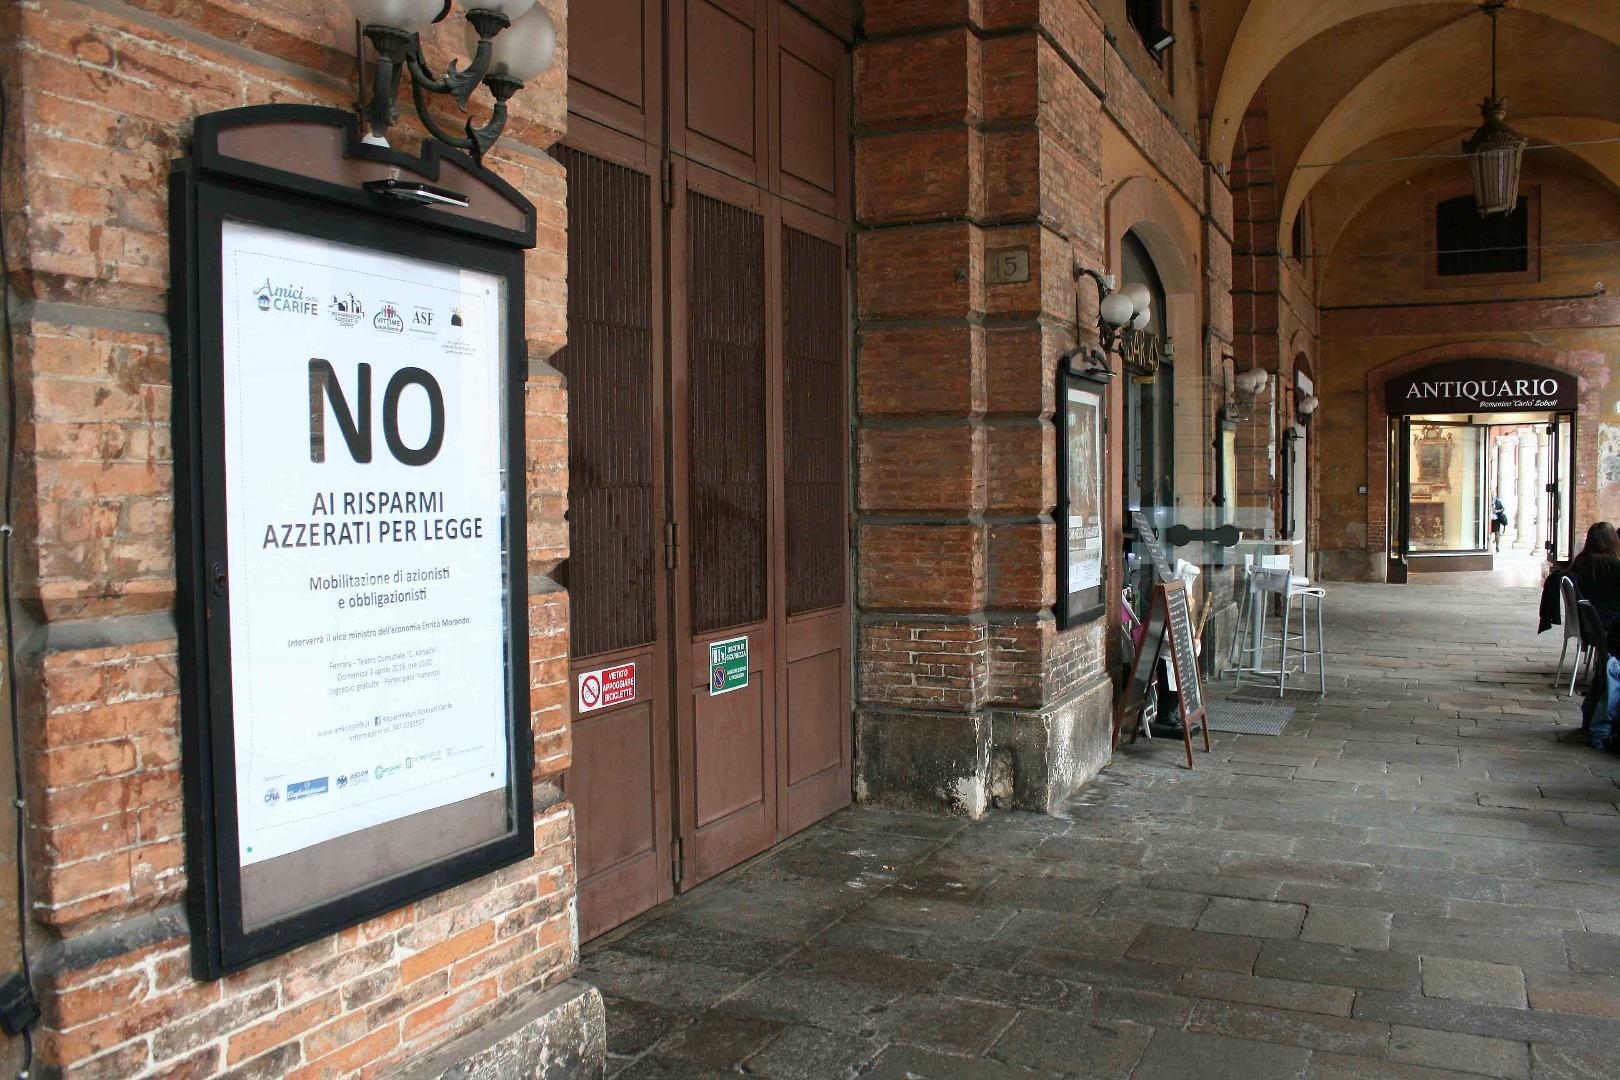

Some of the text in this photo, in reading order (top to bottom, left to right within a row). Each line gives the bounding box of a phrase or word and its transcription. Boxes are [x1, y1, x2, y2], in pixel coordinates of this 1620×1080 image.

[253, 278, 304, 300] Amici
[274, 298, 318, 316] CARIFE
[377, 317, 401, 327] VITTIME
[412, 310, 435, 326] ASF
[1405, 378, 1558, 402] ANTIQUARIO
[308, 357, 445, 467] NO
[312, 491, 444, 516] AI RISPARMI
[262, 517, 483, 549] AZZERATI PER LEGGE
[309, 566, 450, 591] Mobilitazione di azionisti
[338, 587, 427, 609] e obbligazionisti
[332, 633, 347, 642] vice
[349, 629, 377, 640] ministro
[378, 623, 421, 636] dell'economia
[422, 620, 441, 630] Enrico
[442, 616, 470, 628] Morando
[329, 660, 352, 671] Ferrara
[357, 657, 376, 667] Teatro
[377, 653, 405, 666] Comunale
[337, 670, 368, 682] Domenica
[608, 669, 628, 681] VIETATO
[356, 680, 380, 692] gratuito
[602, 677, 634, 692] APPOGGIARE
[604, 688, 633, 702] BICICLETTE
